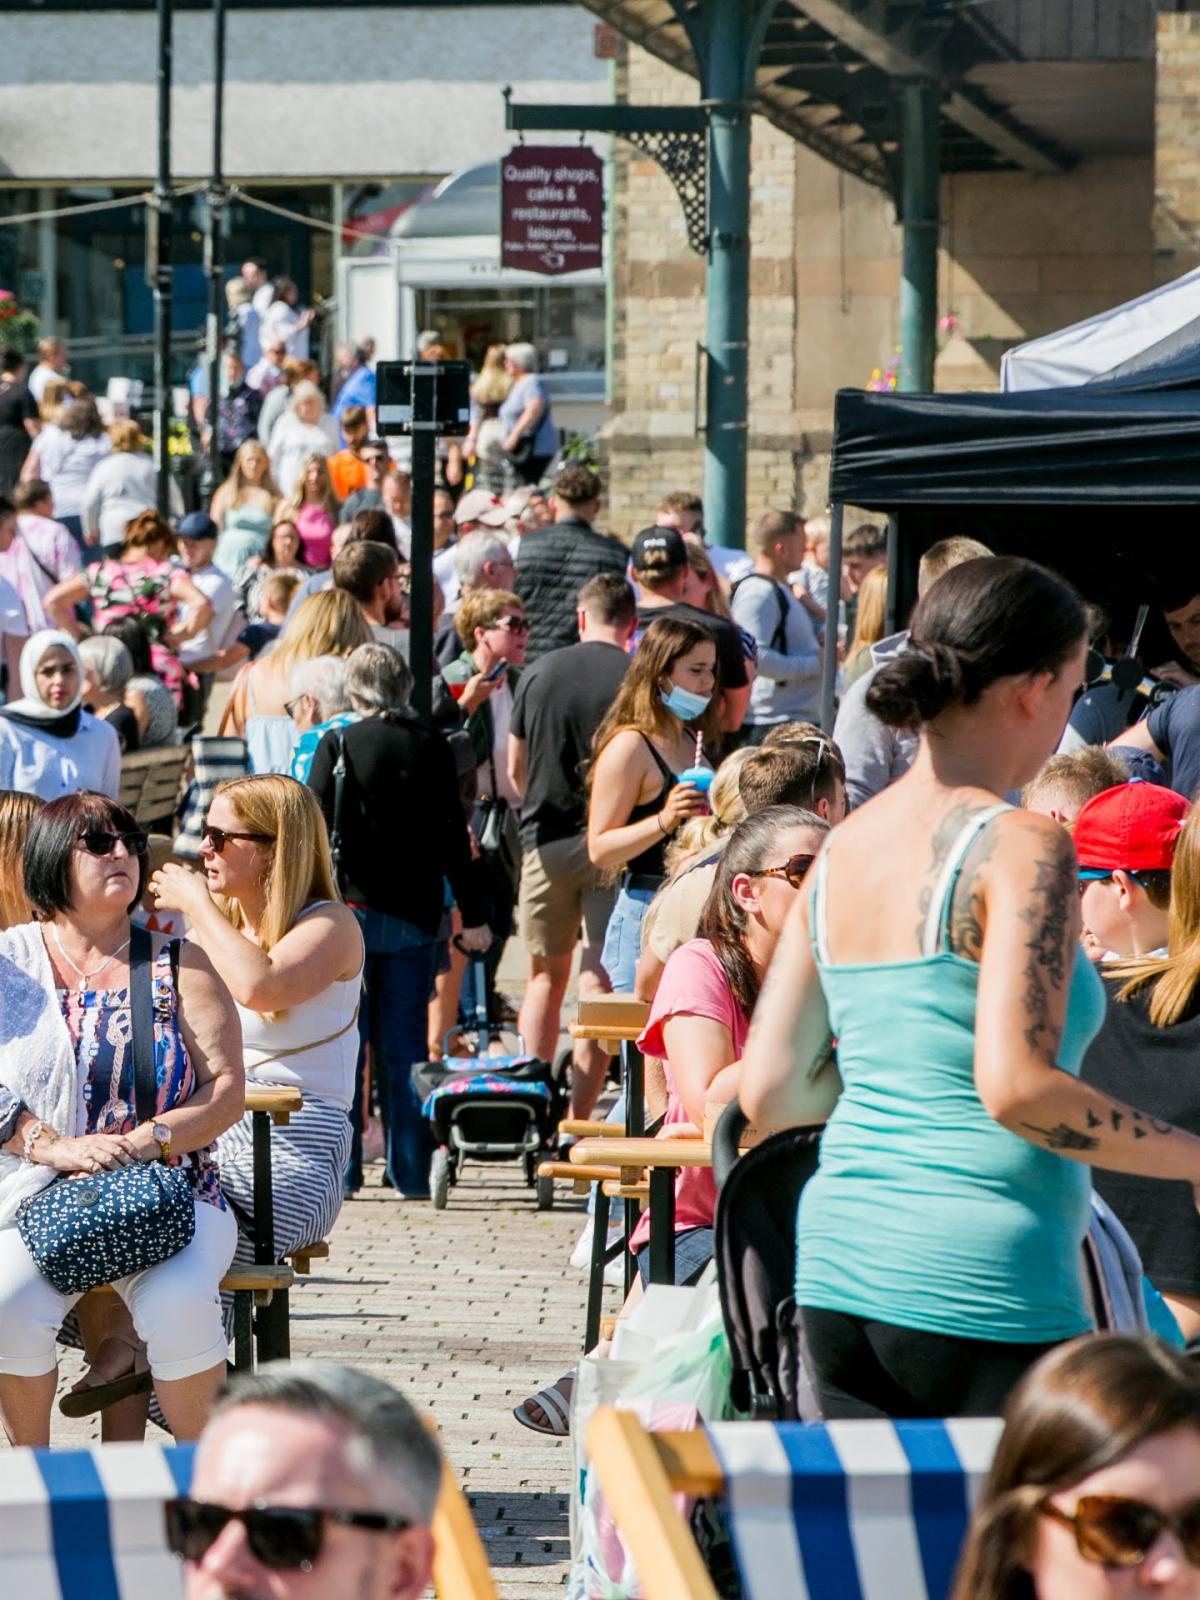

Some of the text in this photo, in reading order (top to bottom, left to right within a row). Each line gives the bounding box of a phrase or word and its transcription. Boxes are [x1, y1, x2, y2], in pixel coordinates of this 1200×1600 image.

[504, 165, 599, 184] Quality shops,
[566, 186, 577, 201] &
[512, 207, 591, 223] restaurants,
[528, 225, 576, 241] leisure,
